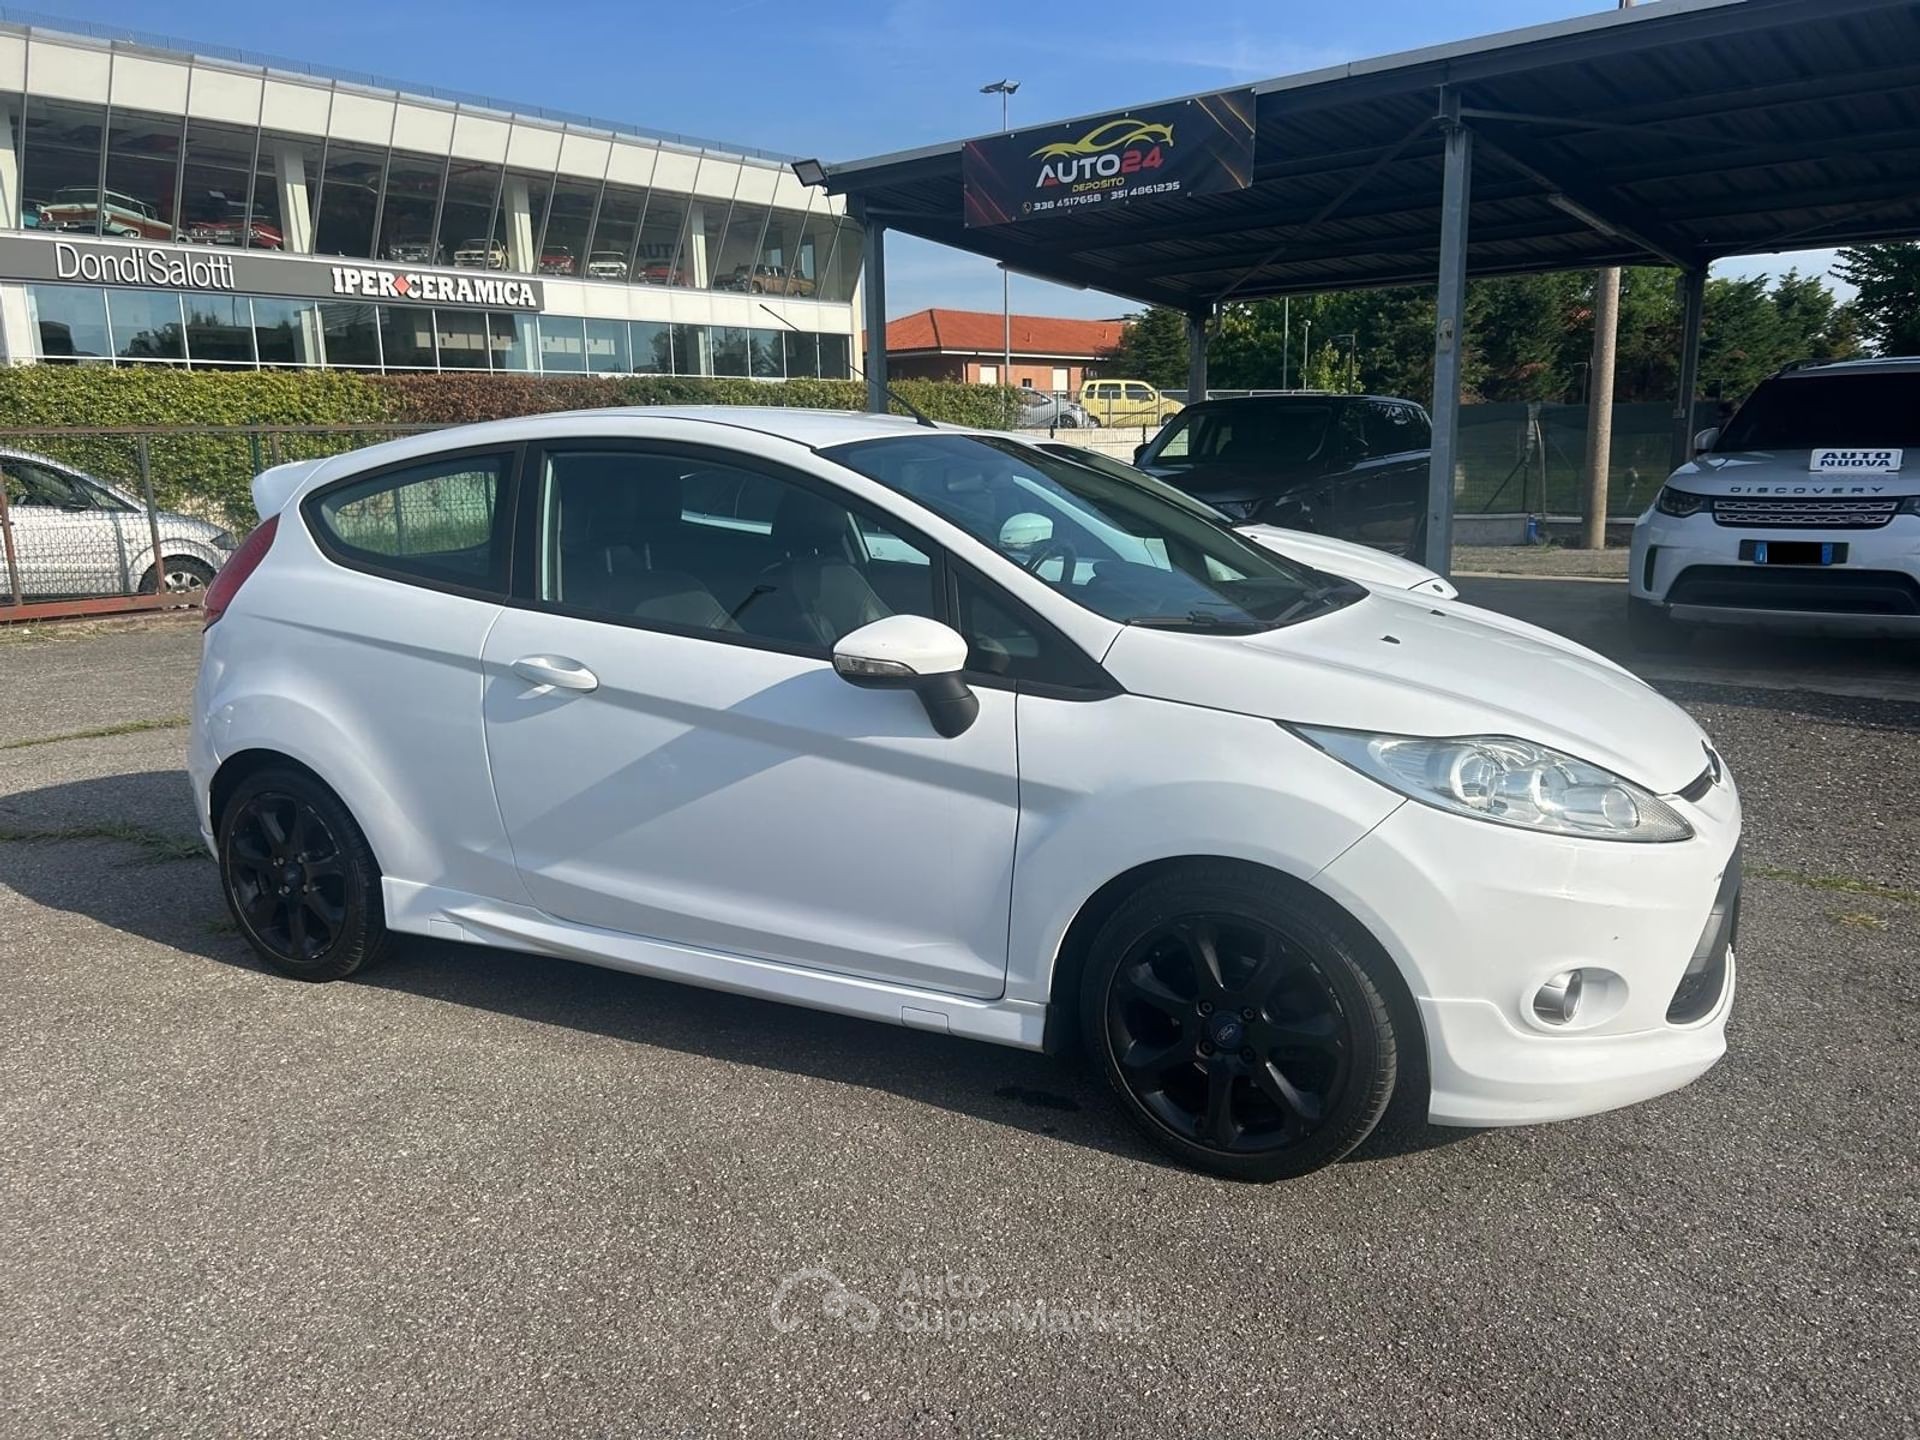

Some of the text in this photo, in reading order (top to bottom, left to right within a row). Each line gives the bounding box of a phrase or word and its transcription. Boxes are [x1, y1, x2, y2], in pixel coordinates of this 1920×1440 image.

[1072, 177, 1125, 192] DEPOSITO
[1821, 452, 1892, 460] AUTO
[1820, 459, 1891, 467] NUOVA
